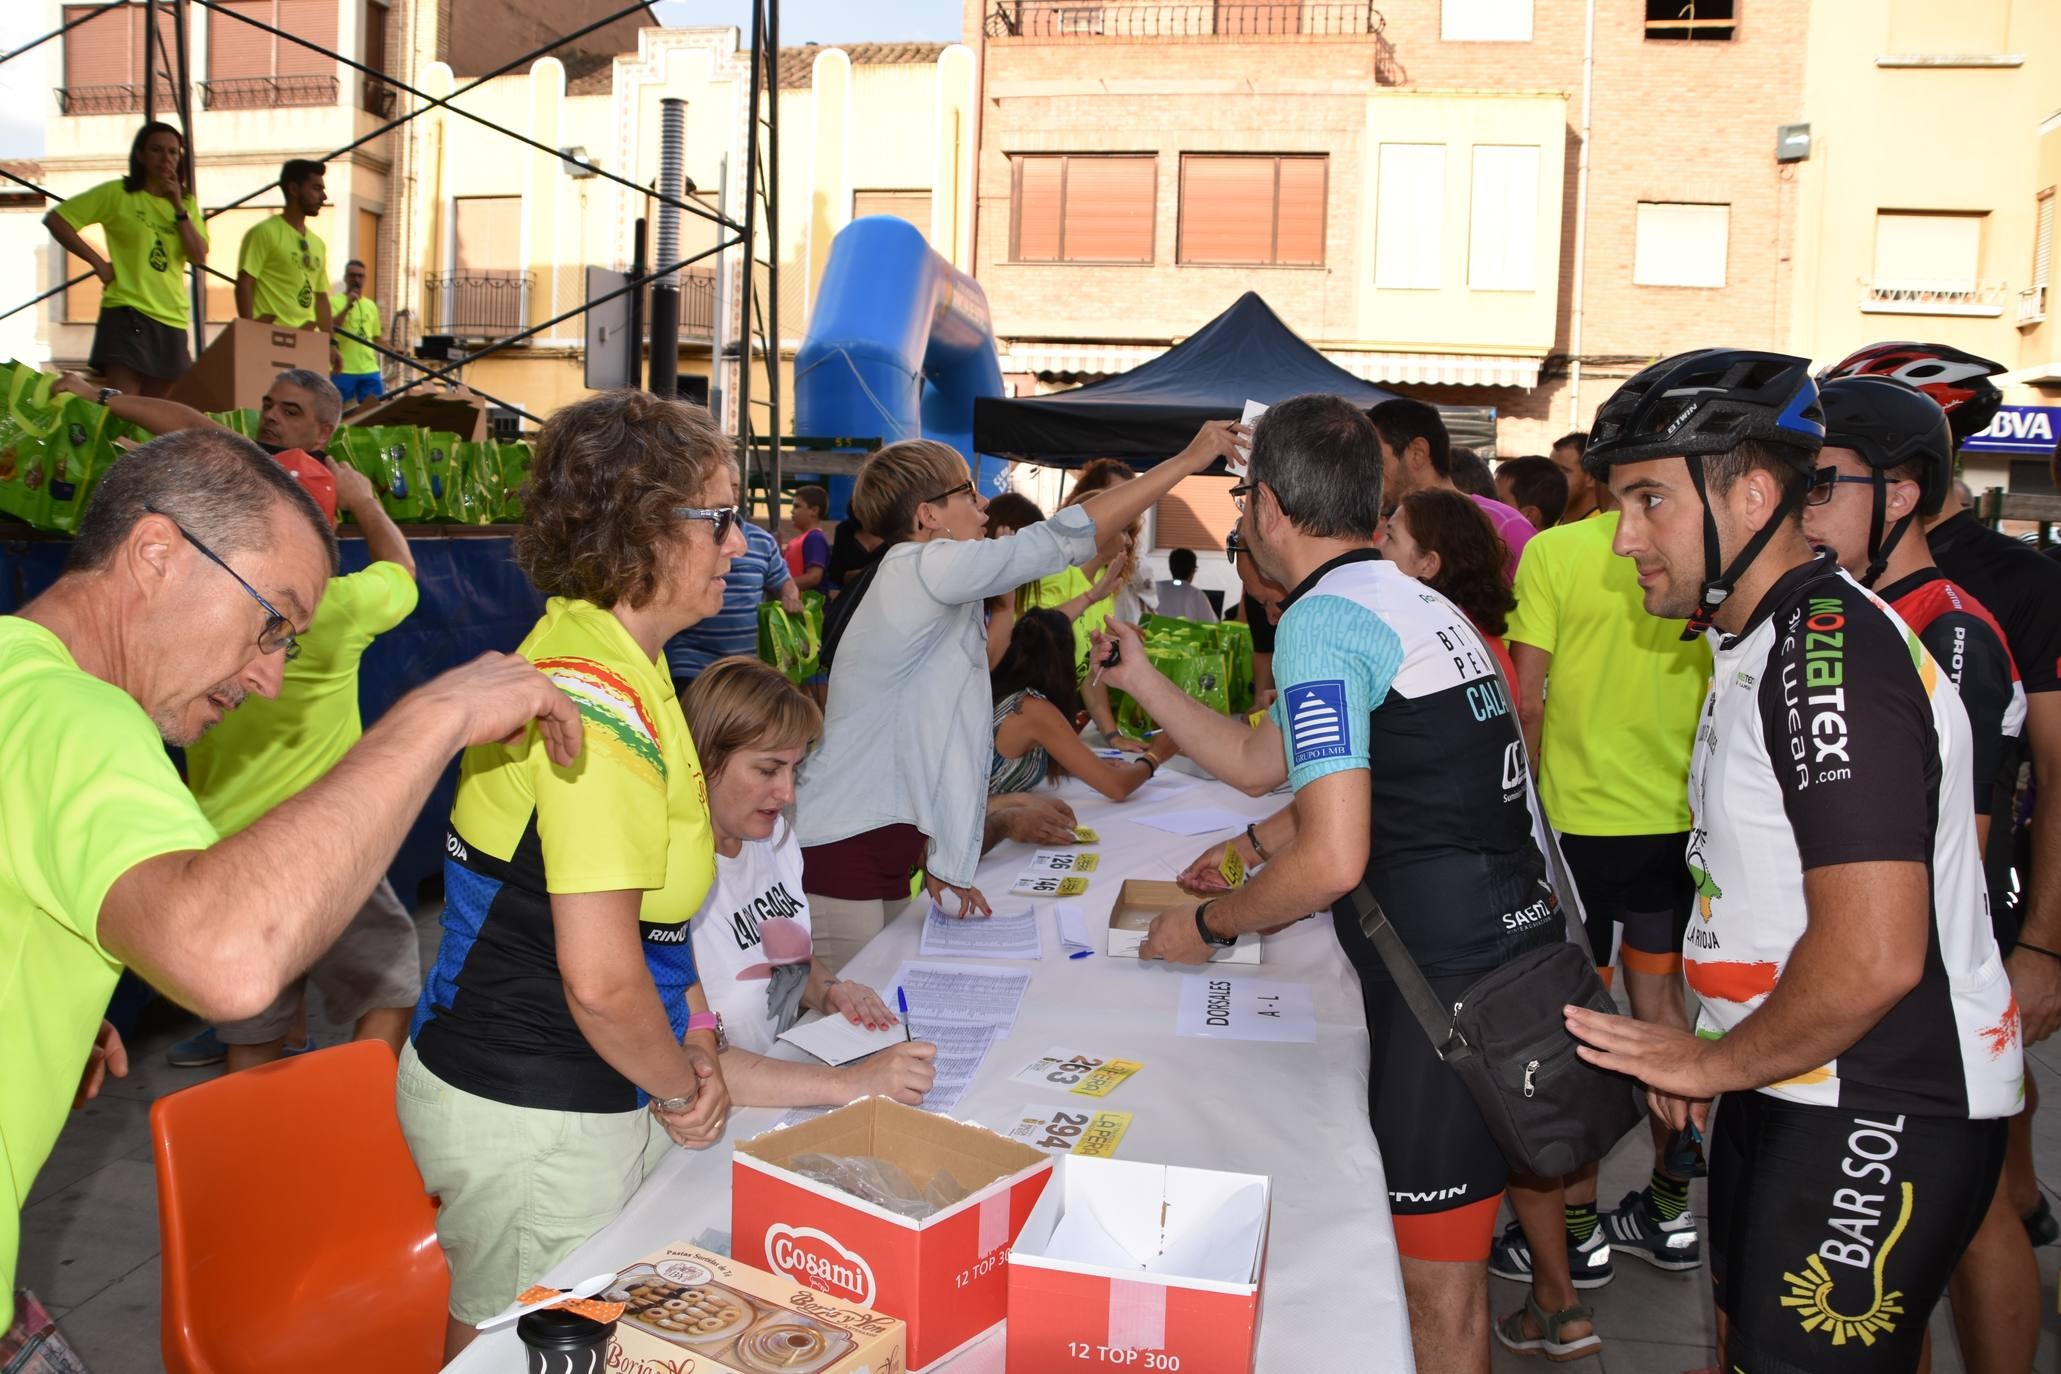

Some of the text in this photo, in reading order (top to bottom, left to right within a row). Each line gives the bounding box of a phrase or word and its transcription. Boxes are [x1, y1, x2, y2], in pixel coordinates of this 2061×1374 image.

[1667, 403, 1698, 434] BTWIN
[1972, 411, 2053, 440] BVA
[1295, 746, 1345, 764] GRUPO LMB
[1815, 767, 1851, 784] .com
[1049, 854, 1075, 871] 126
[1033, 878, 1060, 892] 146
[1695, 930, 1721, 950] RIOJA
[1206, 980, 1231, 1026] DORSALES
[1046, 1055, 1104, 1085] 263
[1035, 1111, 1089, 1149] 294
[1388, 1183, 1467, 1202] TWIN
[1819, 1115, 1906, 1269] BAR SOL
[775, 1239, 864, 1296] Cosami
[955, 1247, 1011, 1289] 12 TOP 30
[1068, 1341, 1181, 1373] 12 TOP 300
